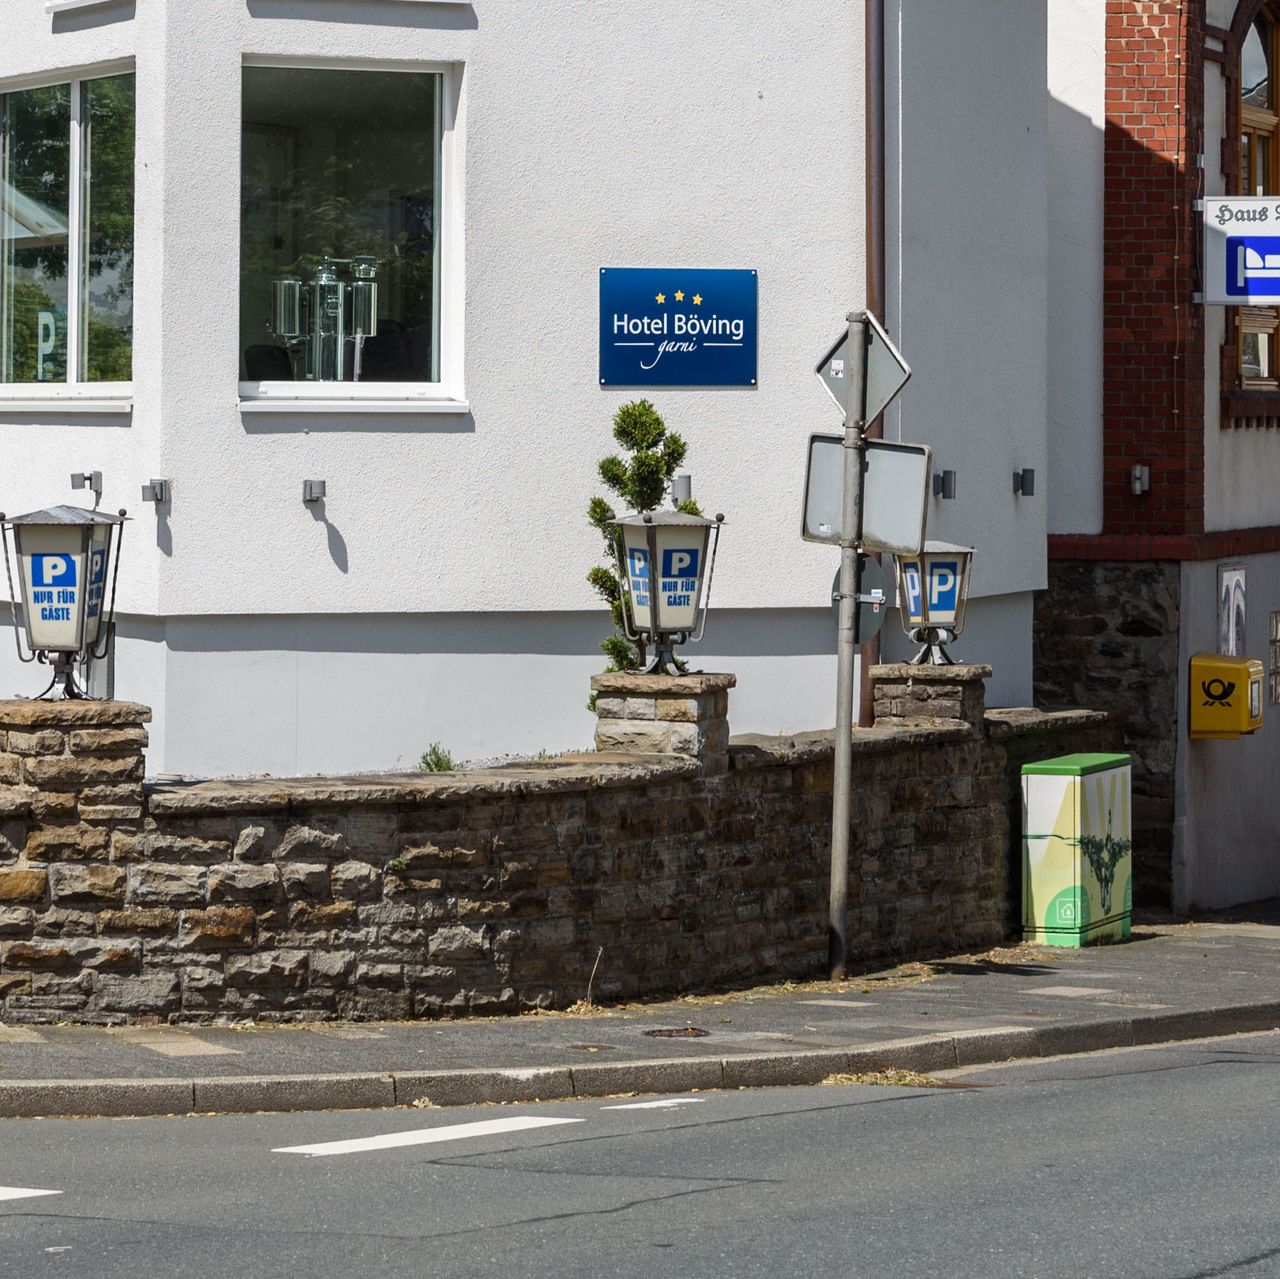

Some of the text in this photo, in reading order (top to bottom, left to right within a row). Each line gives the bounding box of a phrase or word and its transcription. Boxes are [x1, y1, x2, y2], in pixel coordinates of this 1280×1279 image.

[1215, 204, 1268, 225] Haus
[613, 313, 744, 340] Hotel Böving
[640, 337, 698, 370] garni
[42, 556, 67, 584] P
[634, 552, 645, 575] P
[671, 552, 691, 576] P
[33, 591, 53, 604] NUR
[57, 588, 75, 604] FÜR
[662, 581, 678, 592] NUR
[681, 578, 695, 592] FÜR
[905, 568, 920, 613] P
[931, 568, 954, 605] P
[667, 593, 690, 606] GÄSTE
[41, 605, 70, 621] GÄSTE
